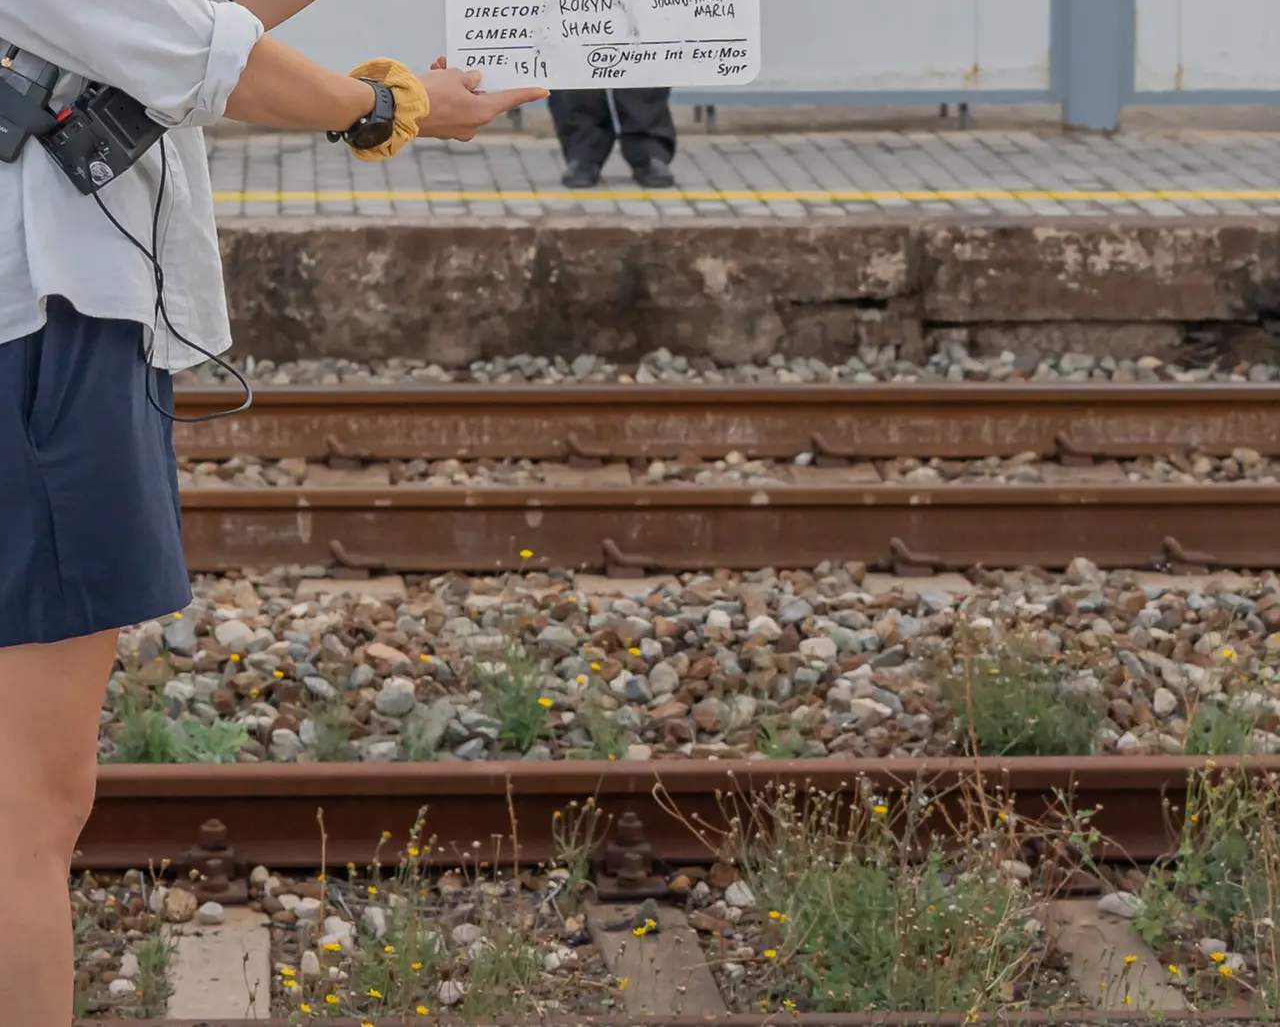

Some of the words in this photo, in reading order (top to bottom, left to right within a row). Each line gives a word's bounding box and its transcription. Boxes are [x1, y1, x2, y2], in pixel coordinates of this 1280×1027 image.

[464, 5, 546, 18] DIRECTOR:
[694, 2, 735, 18] MARIA
[465, 28, 533, 41] CAMERA:
[561, 19, 614, 39] SHANE
[466, 55, 509, 67] DATE:
[591, 51, 617, 64] Day
[620, 48, 657, 62] Night
[664, 49, 683, 60] Int
[719, 47, 747, 59] Mos
[591, 67, 627, 78] Filter
